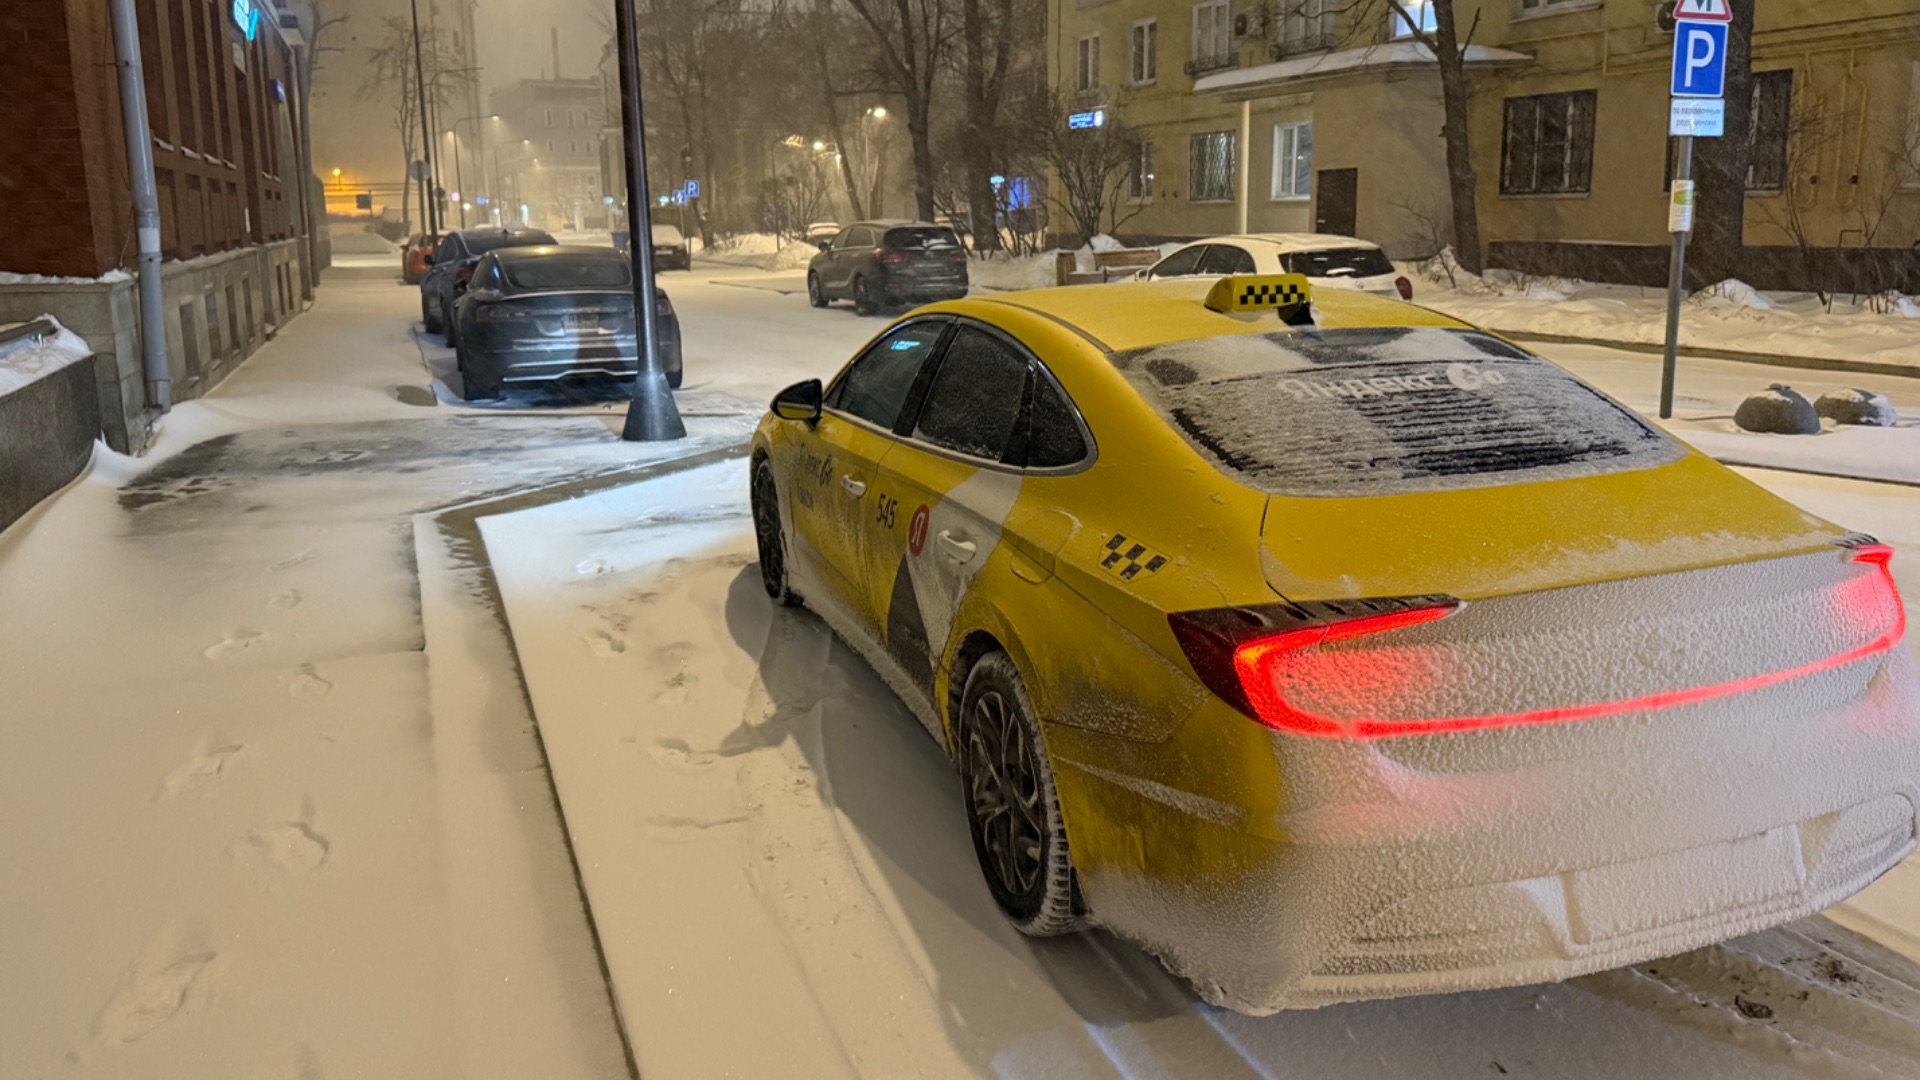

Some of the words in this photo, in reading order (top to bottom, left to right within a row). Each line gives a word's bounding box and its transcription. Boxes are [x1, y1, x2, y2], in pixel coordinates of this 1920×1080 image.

[1684, 29, 1715, 88] P
[688, 181, 697, 195] P
[876, 493, 898, 529] 545
[911, 511, 926, 547] Я
